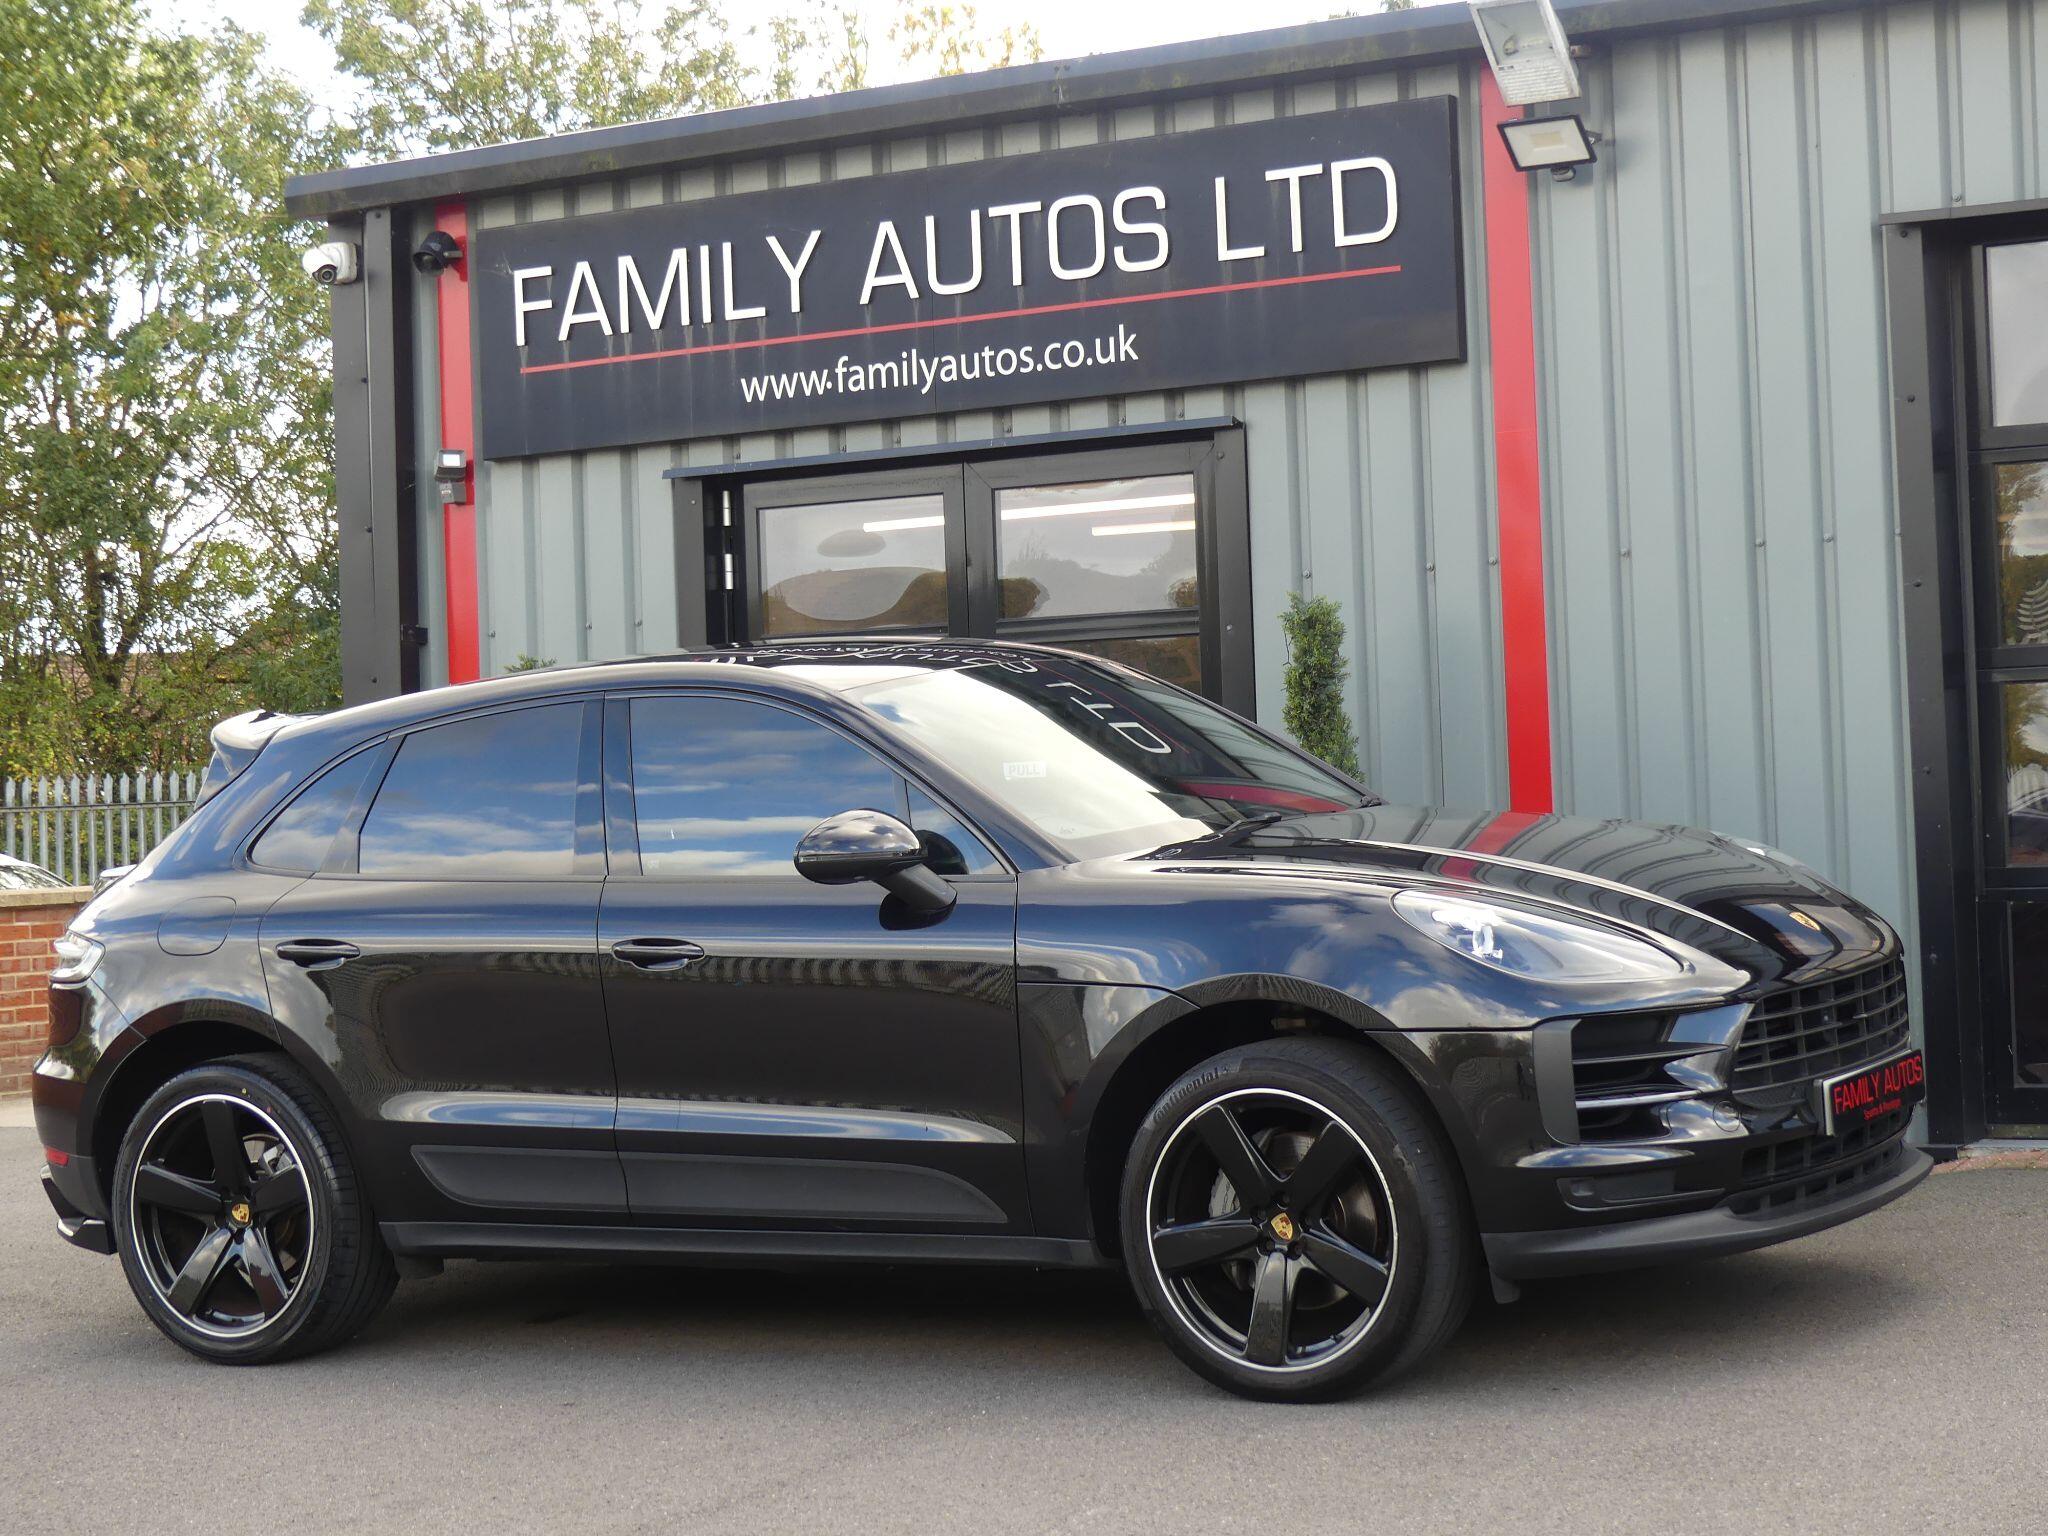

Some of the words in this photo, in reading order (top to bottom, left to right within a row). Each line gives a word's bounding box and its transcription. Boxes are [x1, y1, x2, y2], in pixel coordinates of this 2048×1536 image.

[513, 230, 821, 347] FAMILY
[859, 186, 1169, 305] AUTOS
[1215, 157, 1398, 261] LTD
[740, 324, 1139, 403] www.familyautos.co.uk
[1833, 1072, 1881, 1115] FAMILY
[1884, 1055, 1923, 1095] AUTOS
